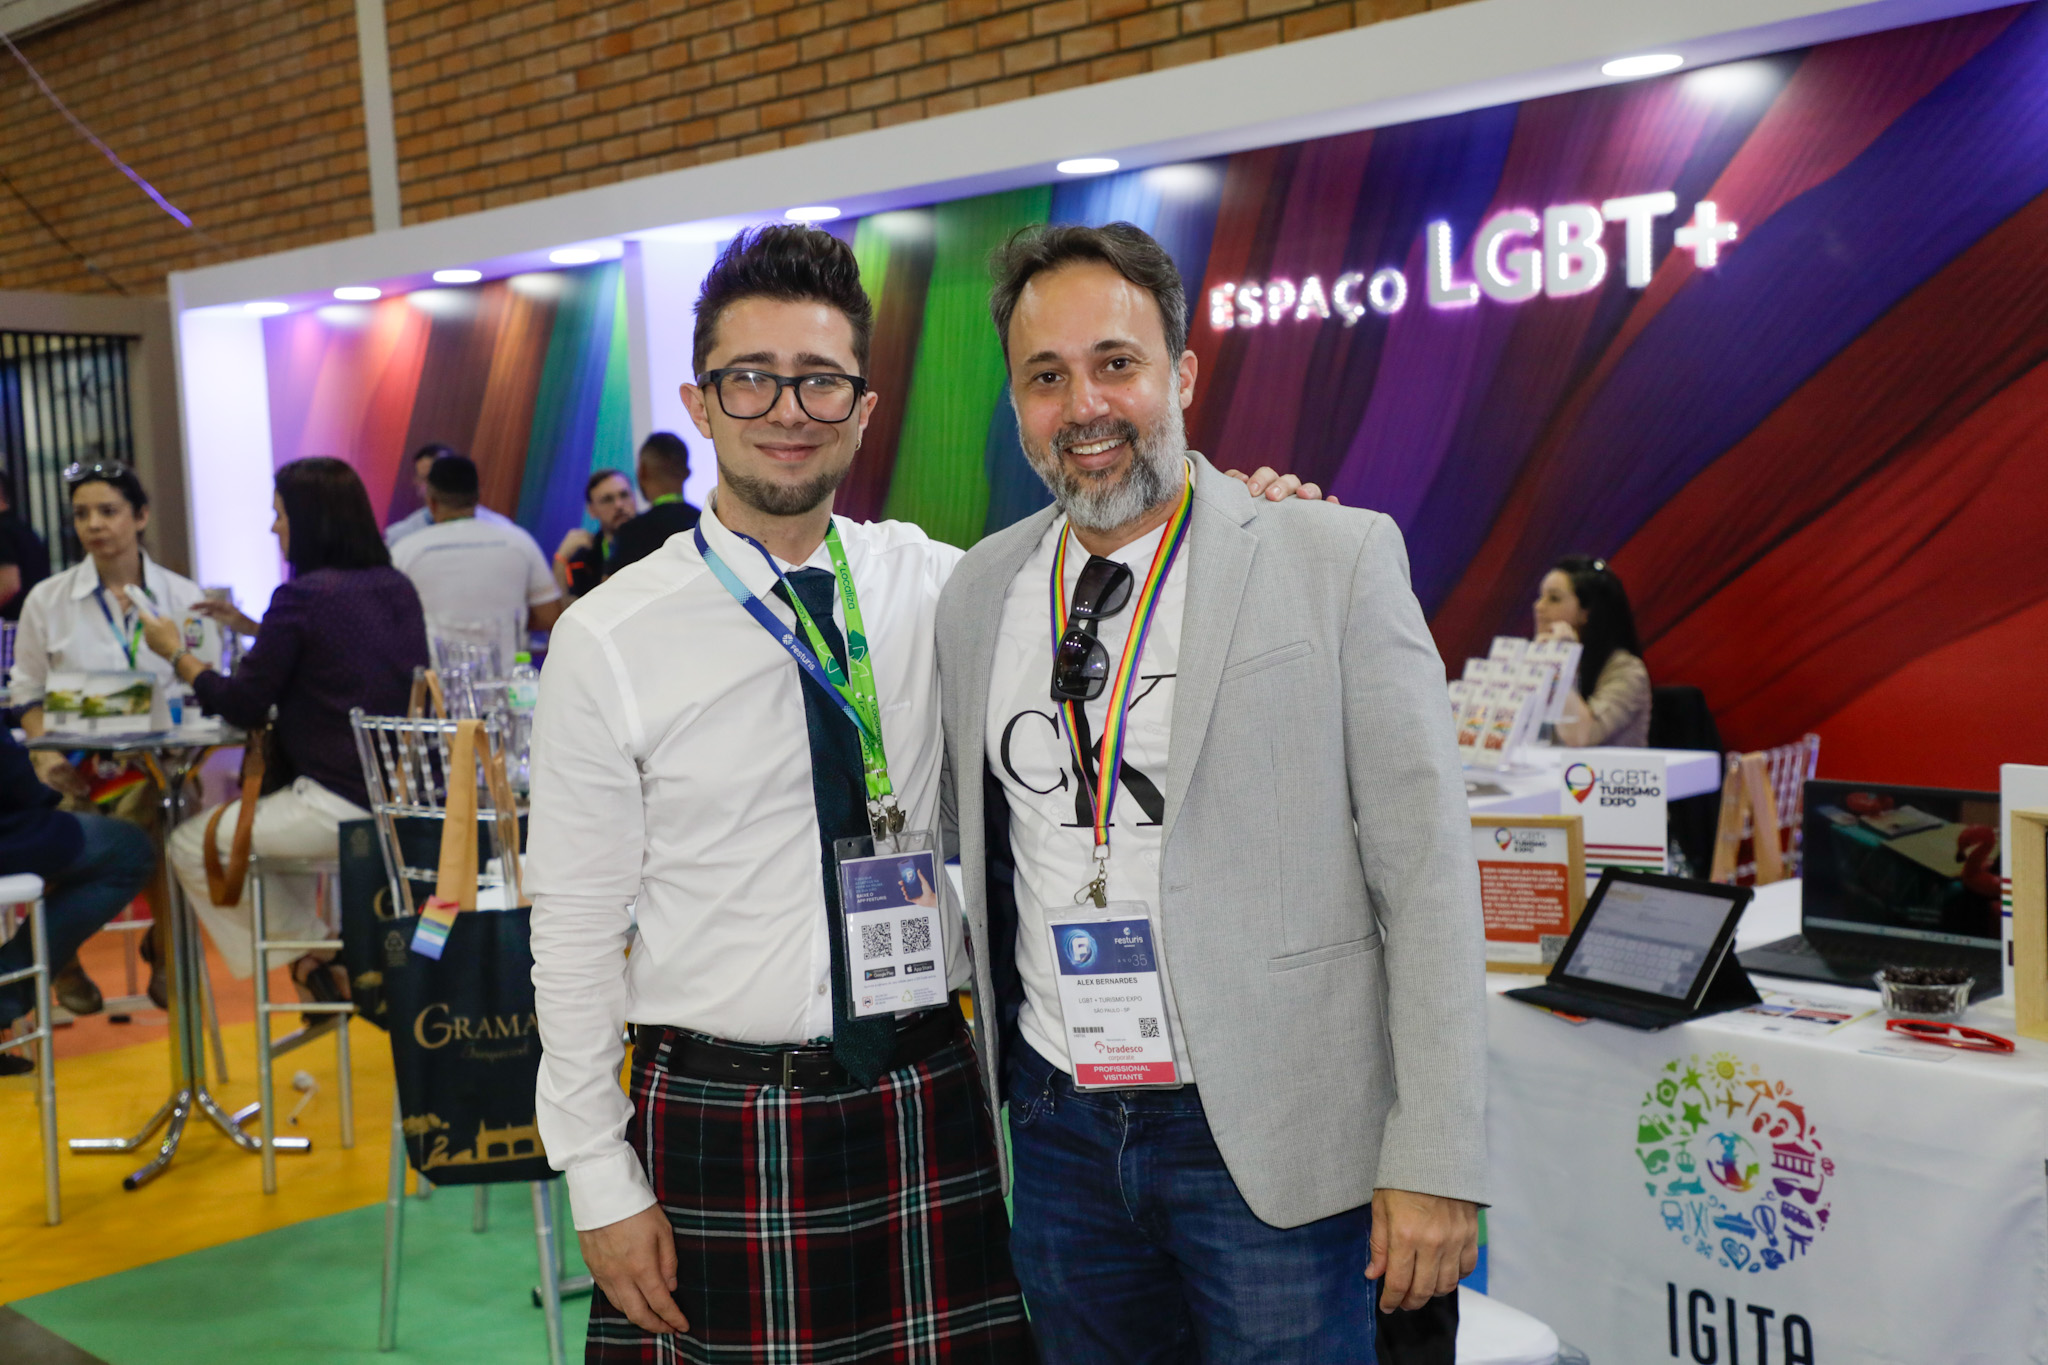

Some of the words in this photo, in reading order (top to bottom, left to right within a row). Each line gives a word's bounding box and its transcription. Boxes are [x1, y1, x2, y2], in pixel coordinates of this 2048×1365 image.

[1209, 267, 1408, 331] ESPAÇO
[1427, 190, 1738, 310] LGBT+
[839, 568, 856, 610] Localiza
[790, 644, 816, 671] Festuris
[1600, 769, 1661, 786] LGBT+
[1600, 785, 1661, 797] TURISMO
[1600, 797, 1637, 808] EXPO
[1131, 953, 1148, 967] 35
[1077, 978, 1094, 986] ALEX
[1095, 977, 1138, 985] BERNARDES
[1106, 1044, 1144, 1054] bradesco
[1093, 1064, 1151, 1073] PROFISSIONAL
[1103, 1073, 1144, 1081] VISITANTE
[1666, 1281, 1815, 1365] IGITA
